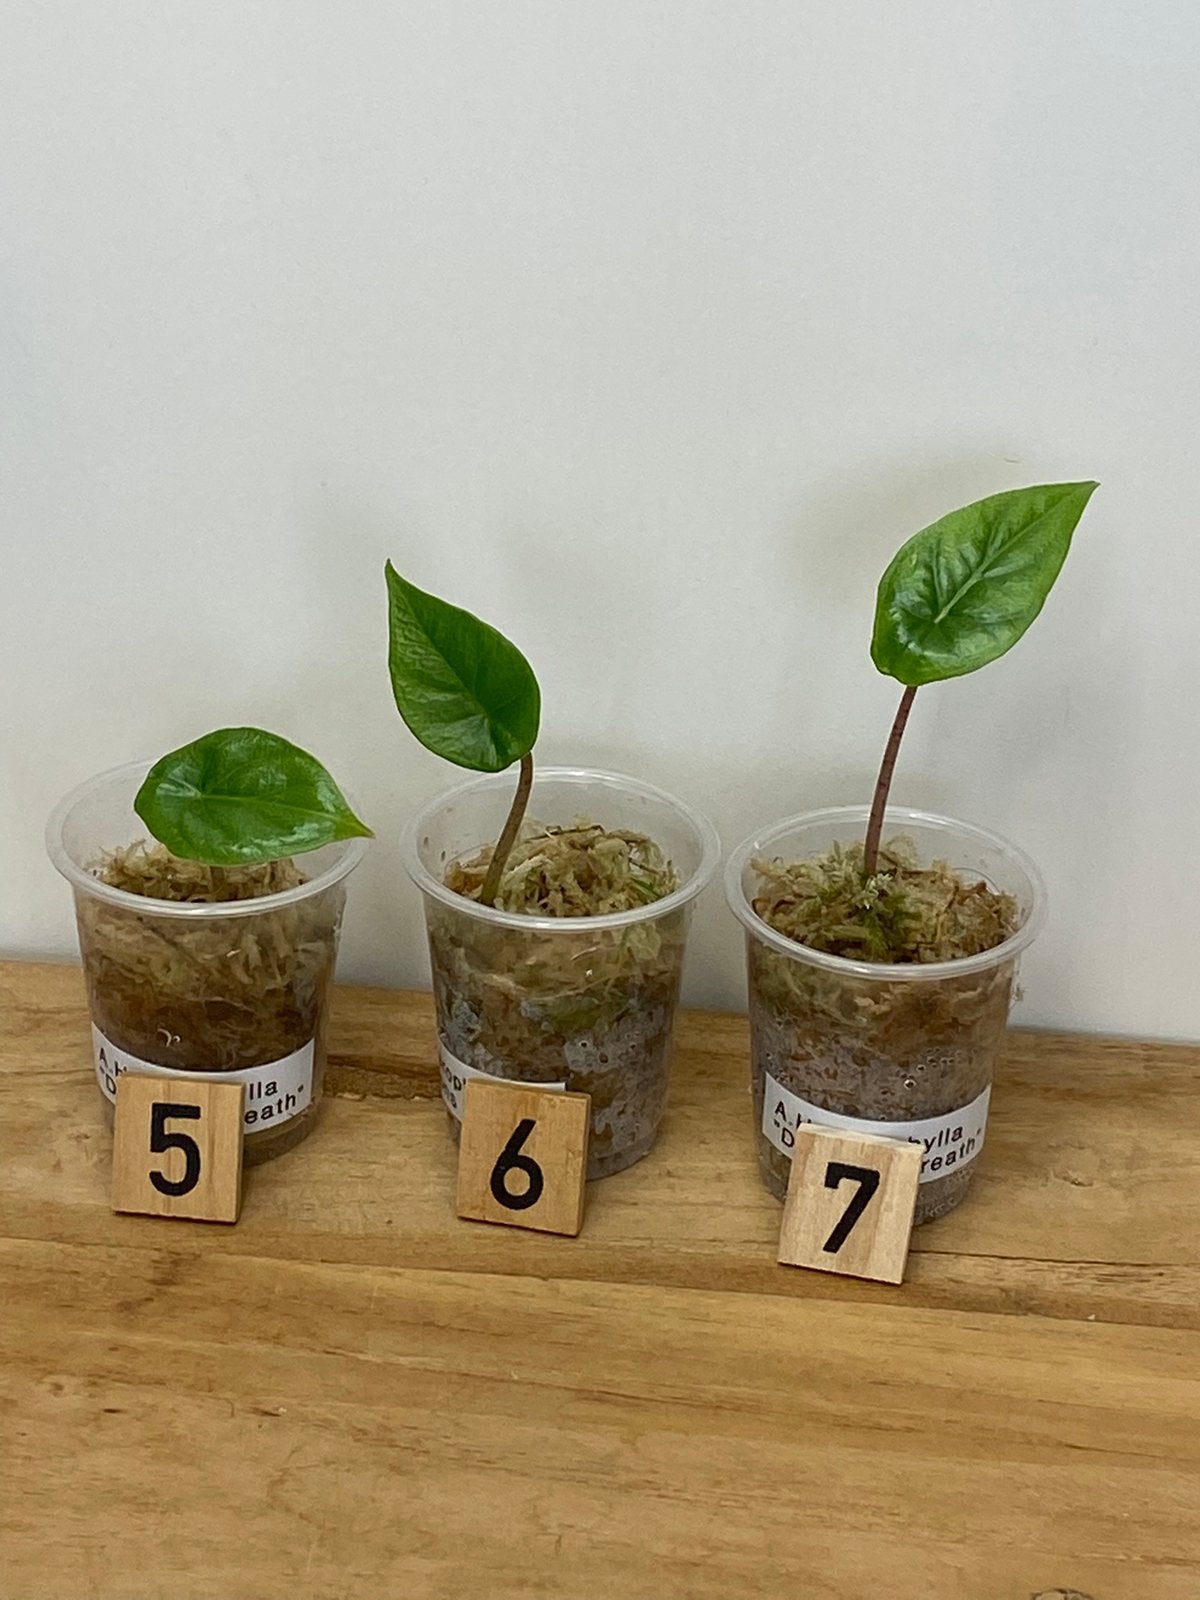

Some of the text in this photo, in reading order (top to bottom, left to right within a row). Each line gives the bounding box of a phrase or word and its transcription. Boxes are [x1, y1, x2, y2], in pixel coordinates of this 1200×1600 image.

[149, 1102, 201, 1197] 5
[490, 1118, 544, 1211] 6
[824, 1161, 880, 1254] 7
